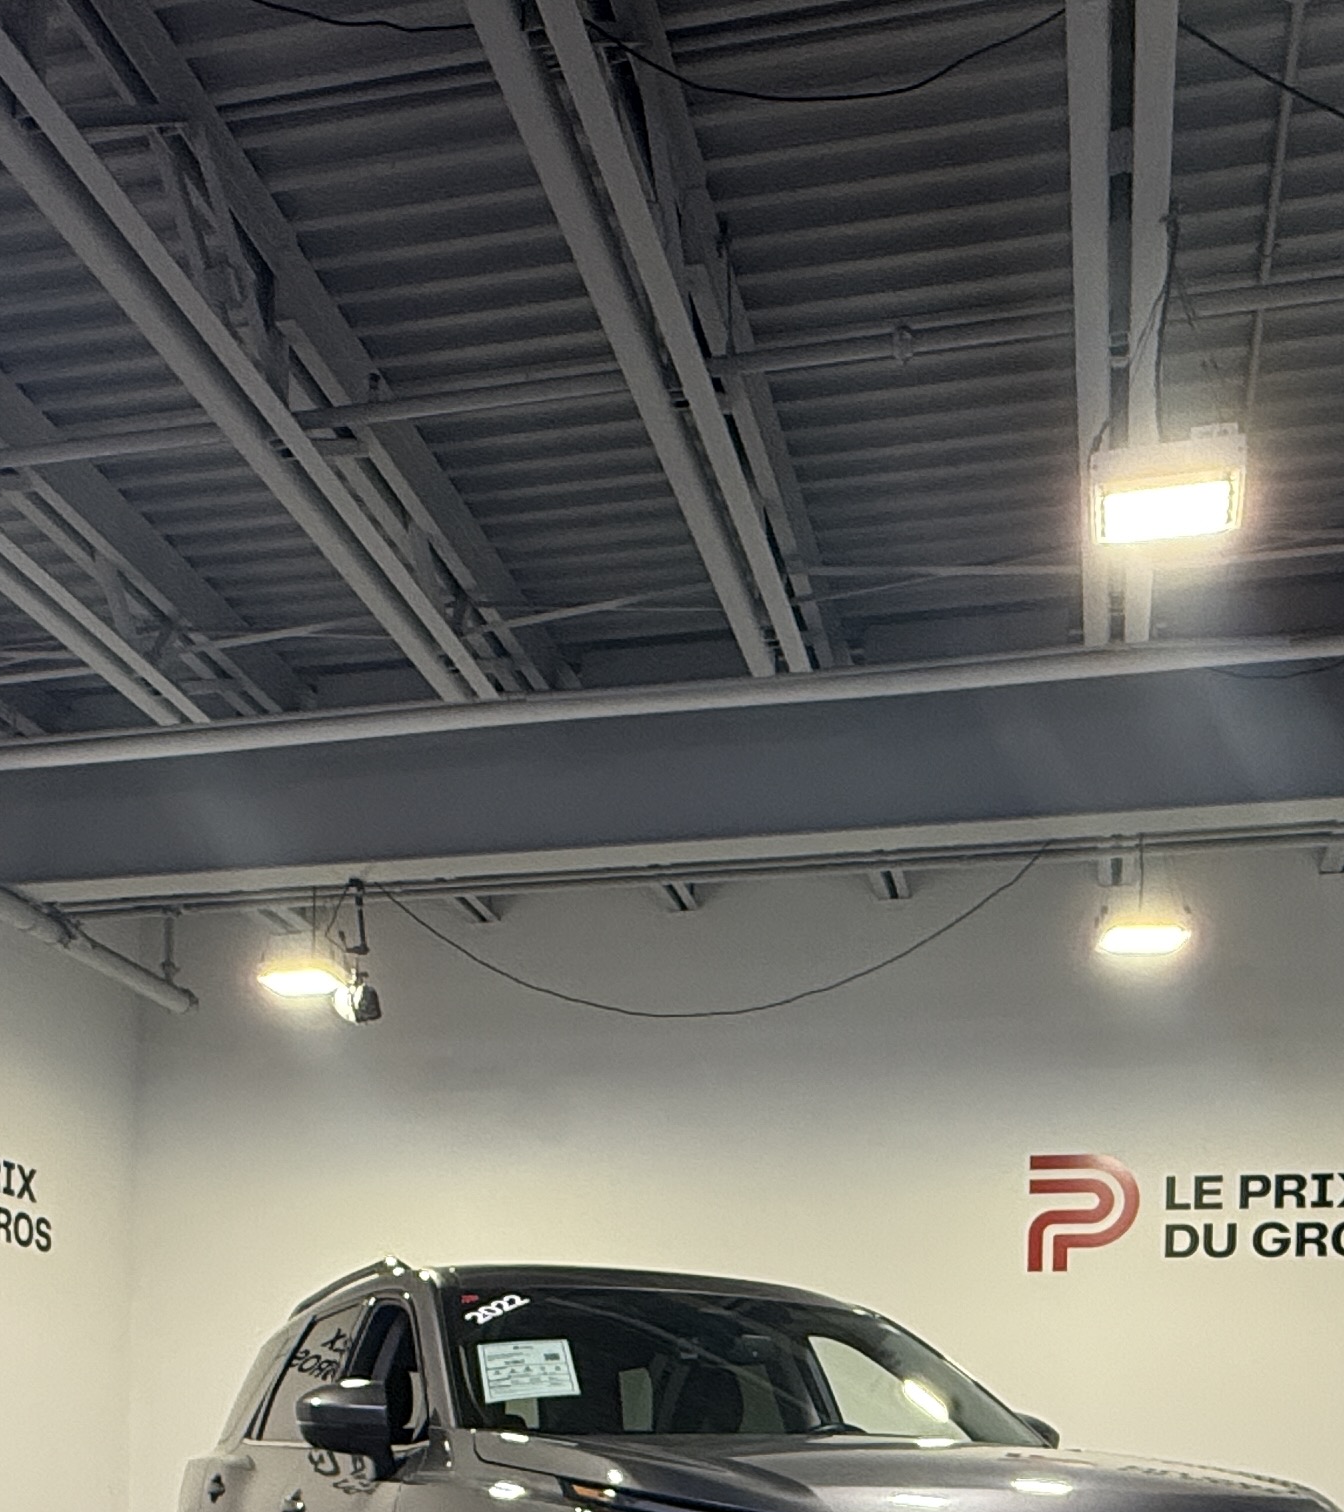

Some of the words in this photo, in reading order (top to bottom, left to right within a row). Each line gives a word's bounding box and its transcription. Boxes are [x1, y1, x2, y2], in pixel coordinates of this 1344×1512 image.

[1164, 1174, 1224, 1211] LE
[1164, 1222, 1238, 1259] DU
[464, 1294, 531, 1325] 2022
